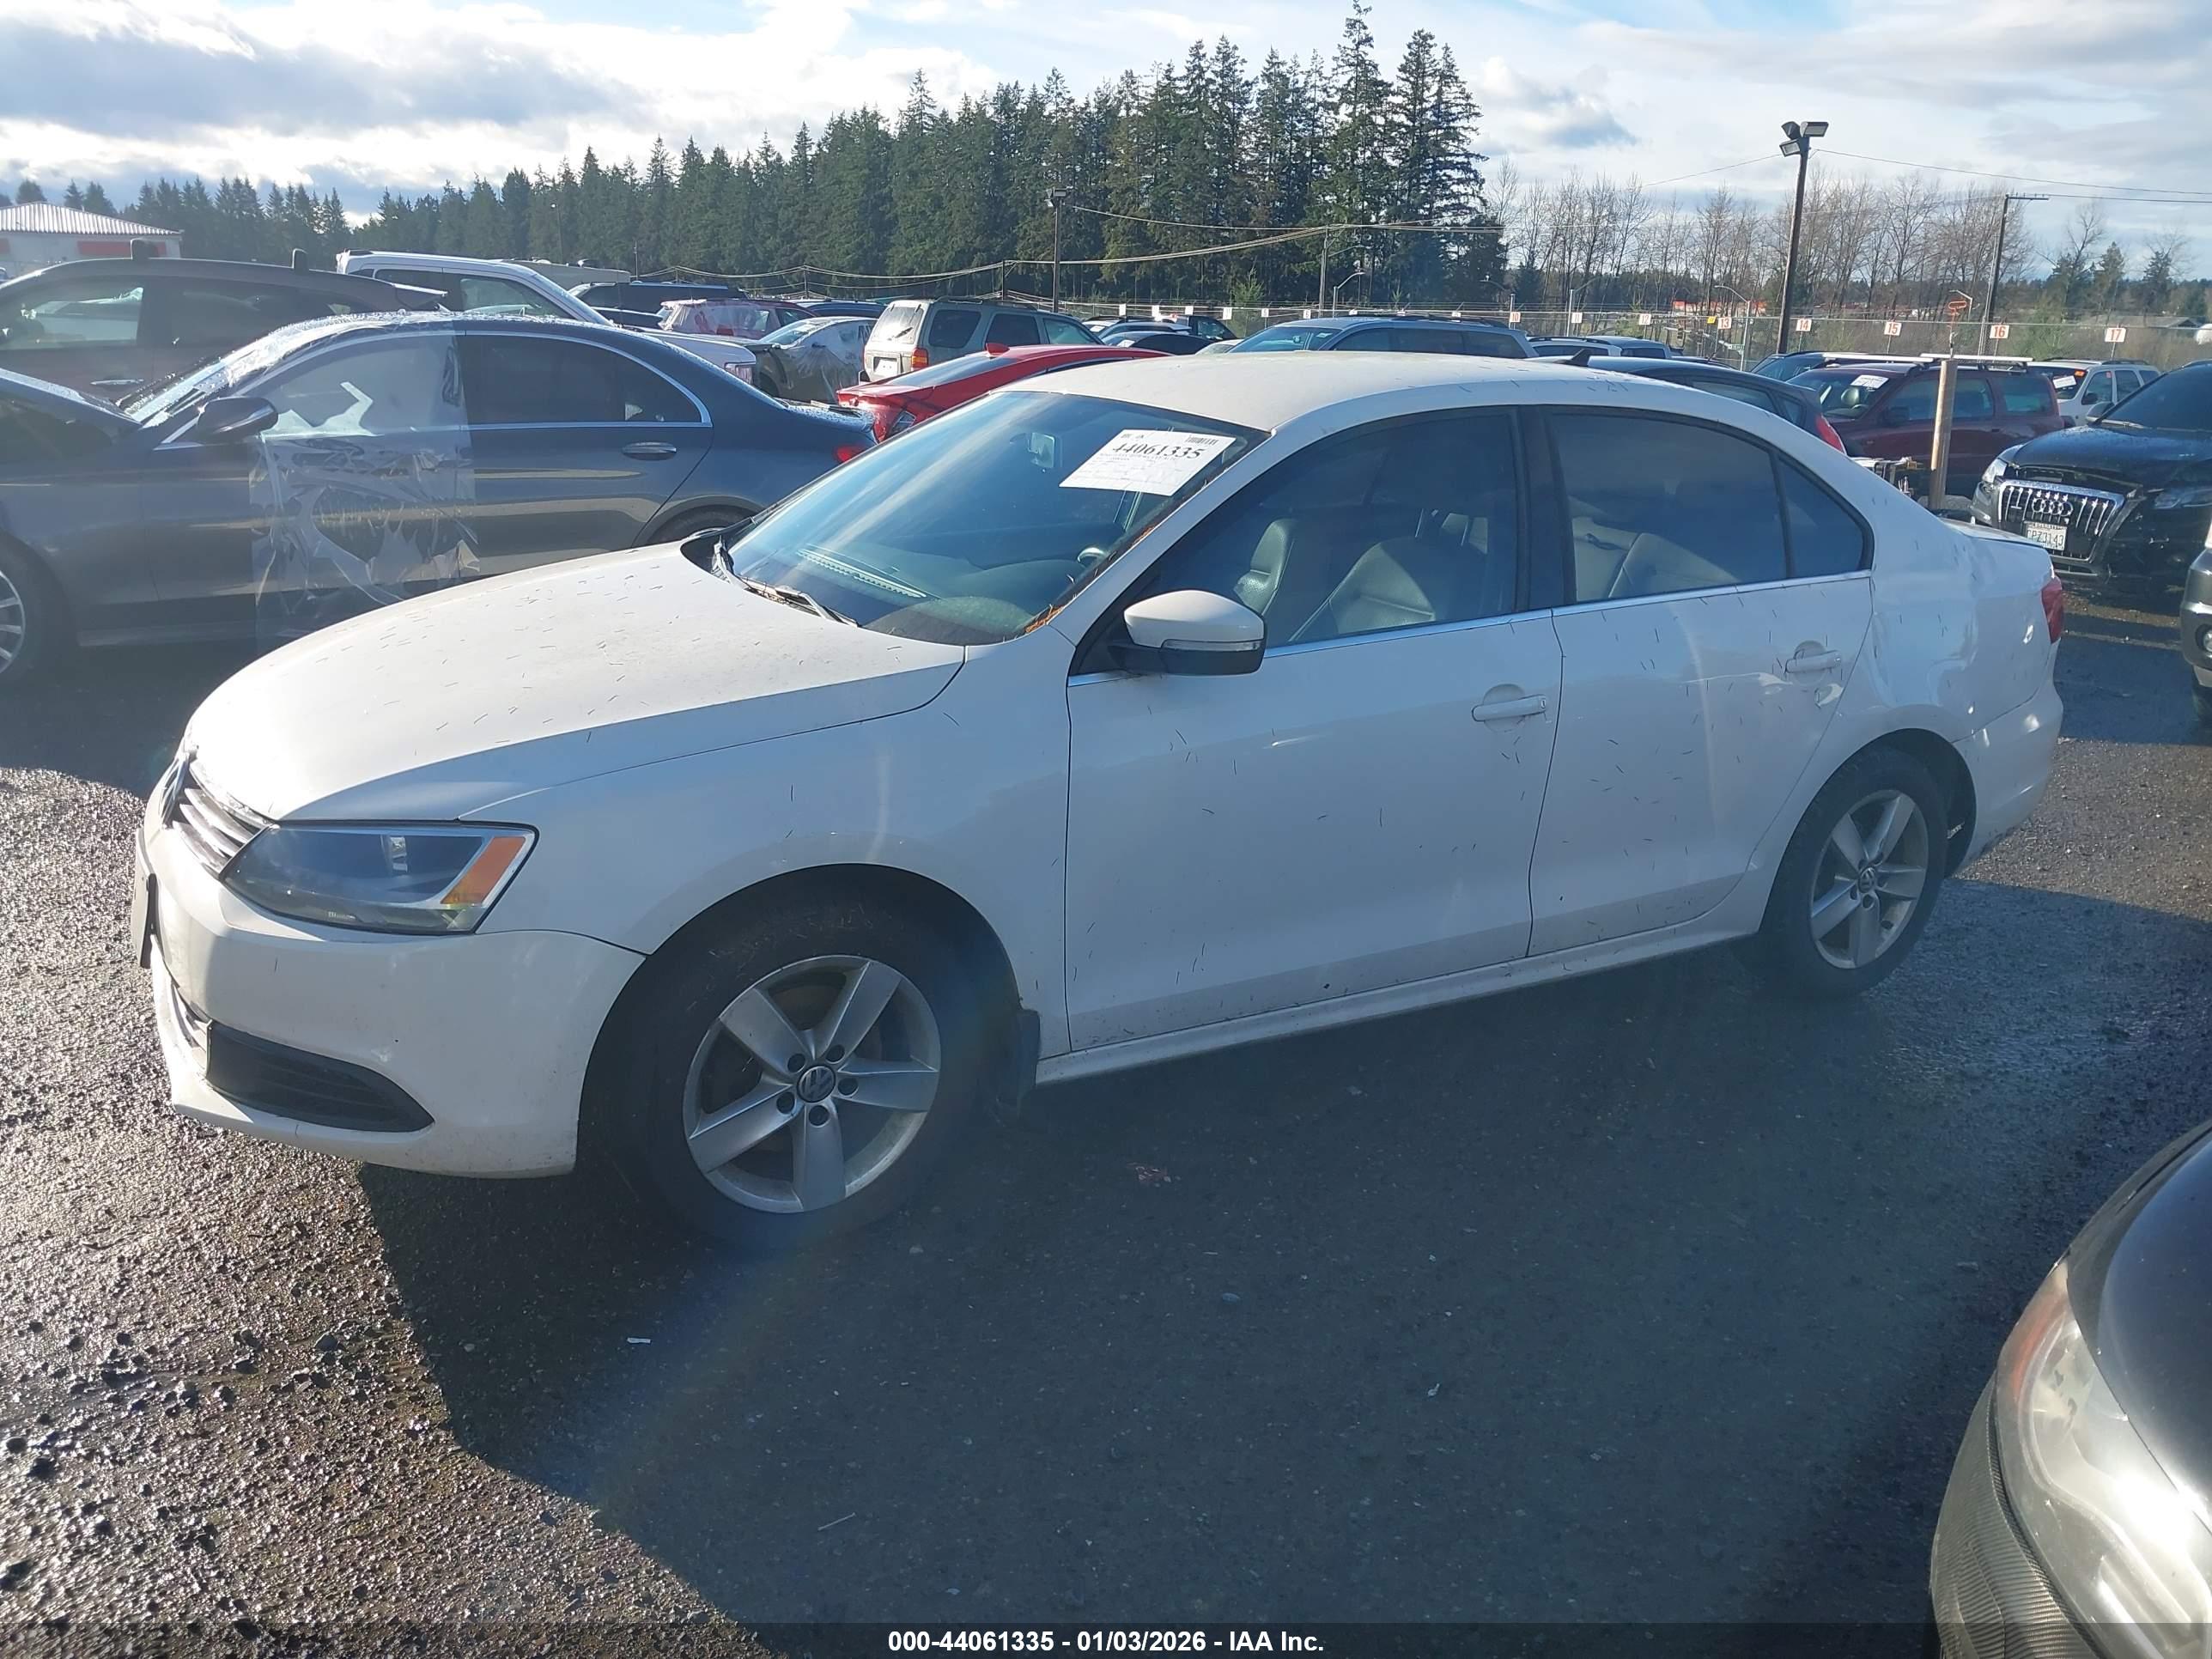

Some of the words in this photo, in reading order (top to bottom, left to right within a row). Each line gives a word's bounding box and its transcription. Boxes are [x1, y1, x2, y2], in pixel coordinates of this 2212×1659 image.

[1720, 319, 1729, 328] 13
[1799, 320, 1808, 330] 14
[1889, 323, 1899, 334] 15
[1994, 326, 2005, 337] 16
[2111, 329, 2122, 340] 17
[1112, 442, 1206, 459] 44061335
